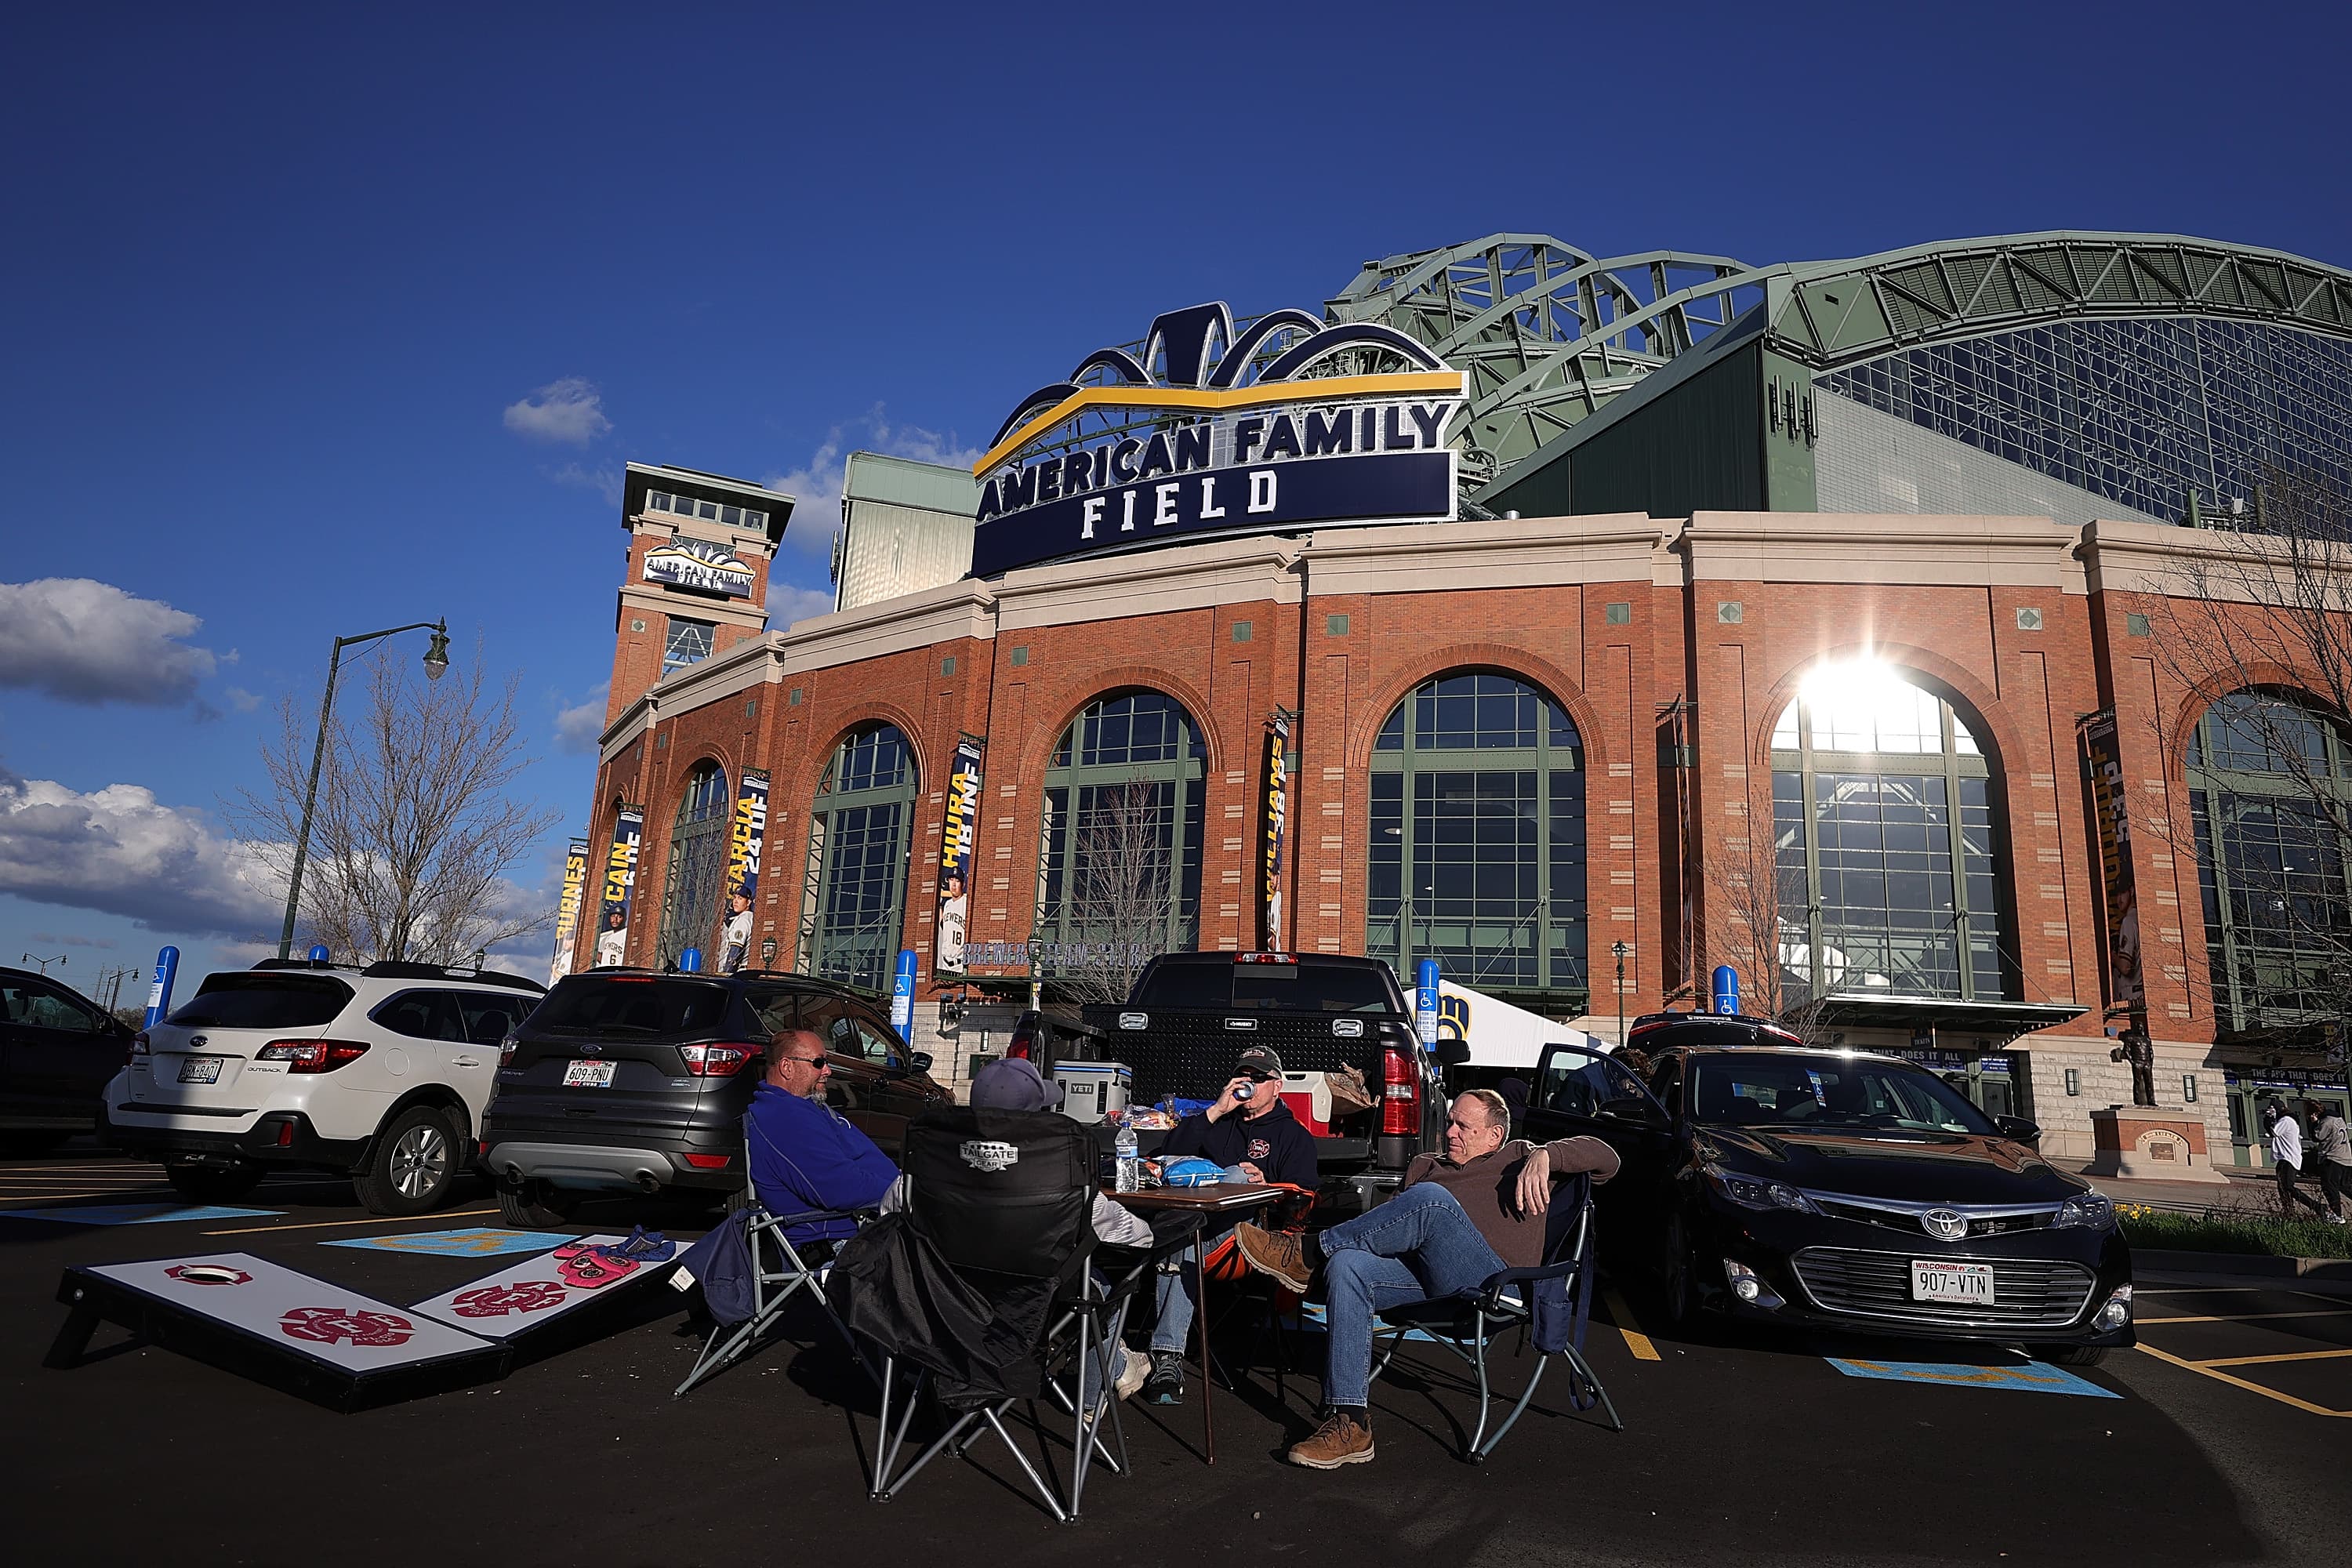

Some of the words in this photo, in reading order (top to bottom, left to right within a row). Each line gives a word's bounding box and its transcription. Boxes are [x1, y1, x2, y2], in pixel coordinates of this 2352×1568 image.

[978, 423, 1214, 523] AMERICAN
[1233, 401, 1462, 464] FAMILY
[1080, 470, 1277, 539] FIELD
[647, 558, 706, 577] AMERICAN
[711, 570, 751, 586] FAMILY
[960, 761, 979, 816] INF
[943, 772, 968, 868] HIURA
[956, 824, 973, 857] 18
[605, 842, 631, 902] CAIN
[953, 931, 962, 946] 18
[610, 954, 616, 965] 6
[1900, 1051, 1925, 1060] DOES
[1929, 1051, 1938, 1061] IT
[1944, 1052, 1960, 1062] ALL
[568, 1068, 610, 1081] 609-PNU
[2251, 1069, 2267, 1078] THE
[2288, 1071, 2307, 1080] THAT
[961, 1147, 1014, 1159] TAILGATE
[1915, 1262, 1958, 1271] WISCONSIN
[1920, 1272, 1986, 1294] 907-VTN
